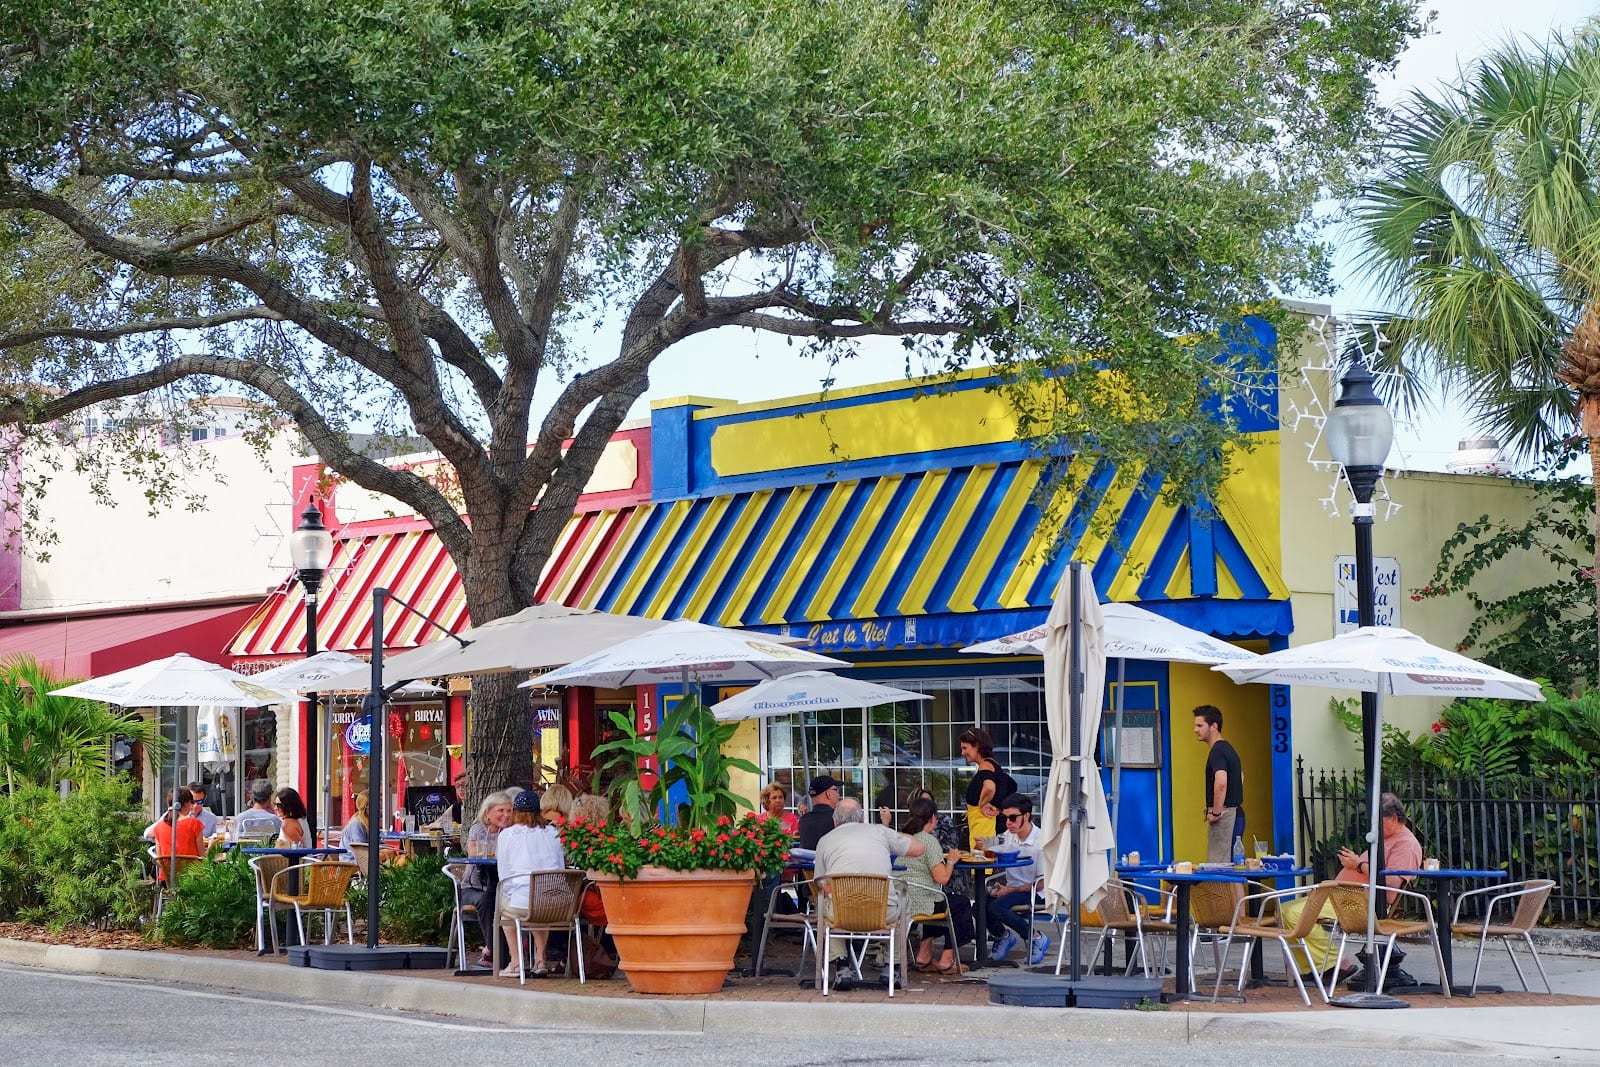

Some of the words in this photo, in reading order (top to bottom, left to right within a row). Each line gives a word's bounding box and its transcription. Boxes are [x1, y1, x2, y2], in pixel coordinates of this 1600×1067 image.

[1374, 566, 1398, 586] 'est
[1376, 608, 1394, 626] ie!
[806, 622, 840, 647] C'est
[843, 624, 857, 643] la
[862, 620, 893, 643] Vie!
[537, 708, 559, 721] WIN
